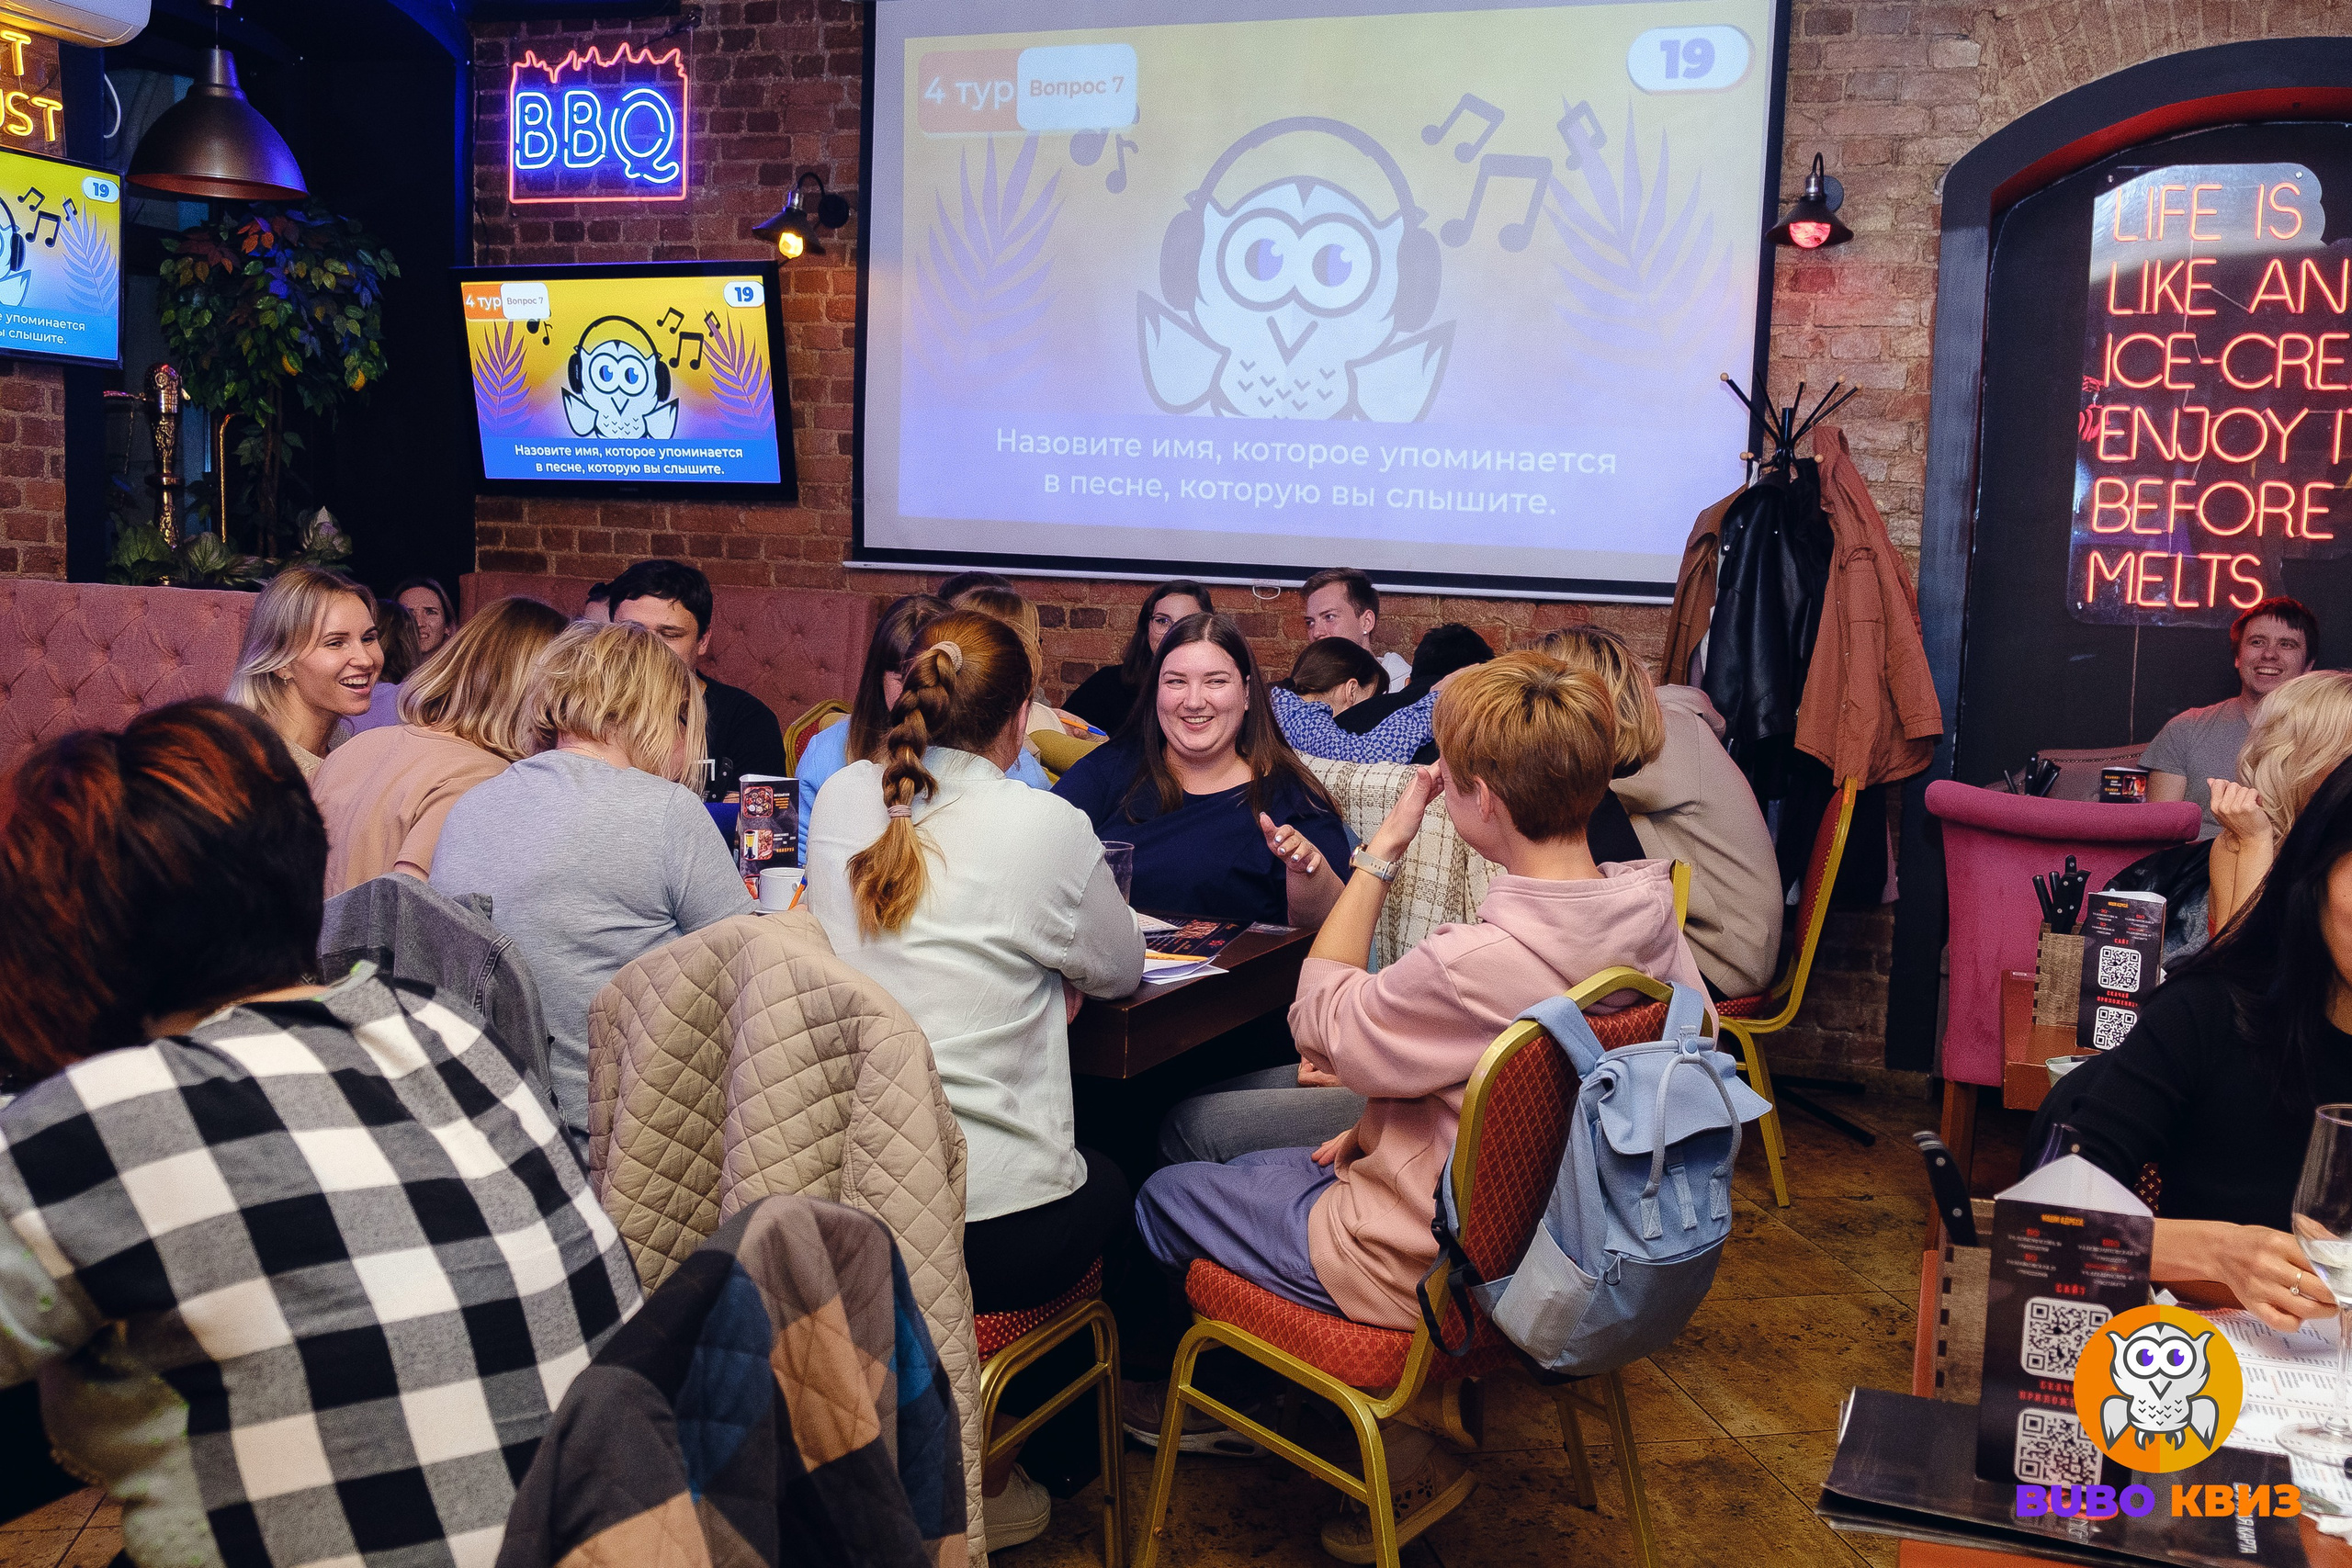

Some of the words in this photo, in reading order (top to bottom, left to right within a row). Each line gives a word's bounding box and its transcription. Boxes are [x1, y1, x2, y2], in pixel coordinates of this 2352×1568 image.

[1659, 38, 1715, 79] 19
[923, 75, 945, 105] 4
[956, 80, 1015, 111] тур
[1029, 79, 1106, 98] Вопрос
[1113, 76, 1125, 93] 7
[0, 88, 63, 141] ST
[515, 88, 680, 184] BBQ
[93, 182, 109, 197] 19
[2114, 184, 2222, 242] LIFE
[2255, 182, 2302, 240] IS
[465, 294, 475, 308] 4
[478, 297, 501, 310] тур
[506, 298, 537, 306] Вопрос
[734, 287, 754, 302] 19
[2108, 258, 2217, 315] LIKE
[2248, 258, 2349, 314] AN
[6, 313, 85, 332] упоминается
[8, 330, 67, 344] слышите.
[2104, 333, 2352, 390] ICE-CRE
[514, 445, 571, 456] Назовите
[575, 446, 603, 458] имя,
[605, 447, 656, 459] которое
[659, 447, 743, 460] упоминается
[996, 428, 1142, 457] Назовите
[1152, 439, 1222, 465] имя,
[1233, 441, 1370, 469] которое
[1379, 446, 1616, 474] упоминается
[2098, 405, 2309, 463] ENJOY
[2333, 408, 2352, 465] I
[536, 463, 543, 472] в
[546, 463, 585, 474] песне,
[588, 464, 640, 476] которую
[644, 465, 661, 473] вы
[663, 465, 725, 475] слышите.
[1044, 474, 1060, 493] в
[1070, 475, 1170, 502] песне,
[1181, 479, 1320, 509] которую
[1332, 485, 1374, 507] вы
[1386, 488, 1556, 514] слышите.
[2092, 477, 2335, 539] BEFORE
[2086, 551, 2264, 609] MELTS
